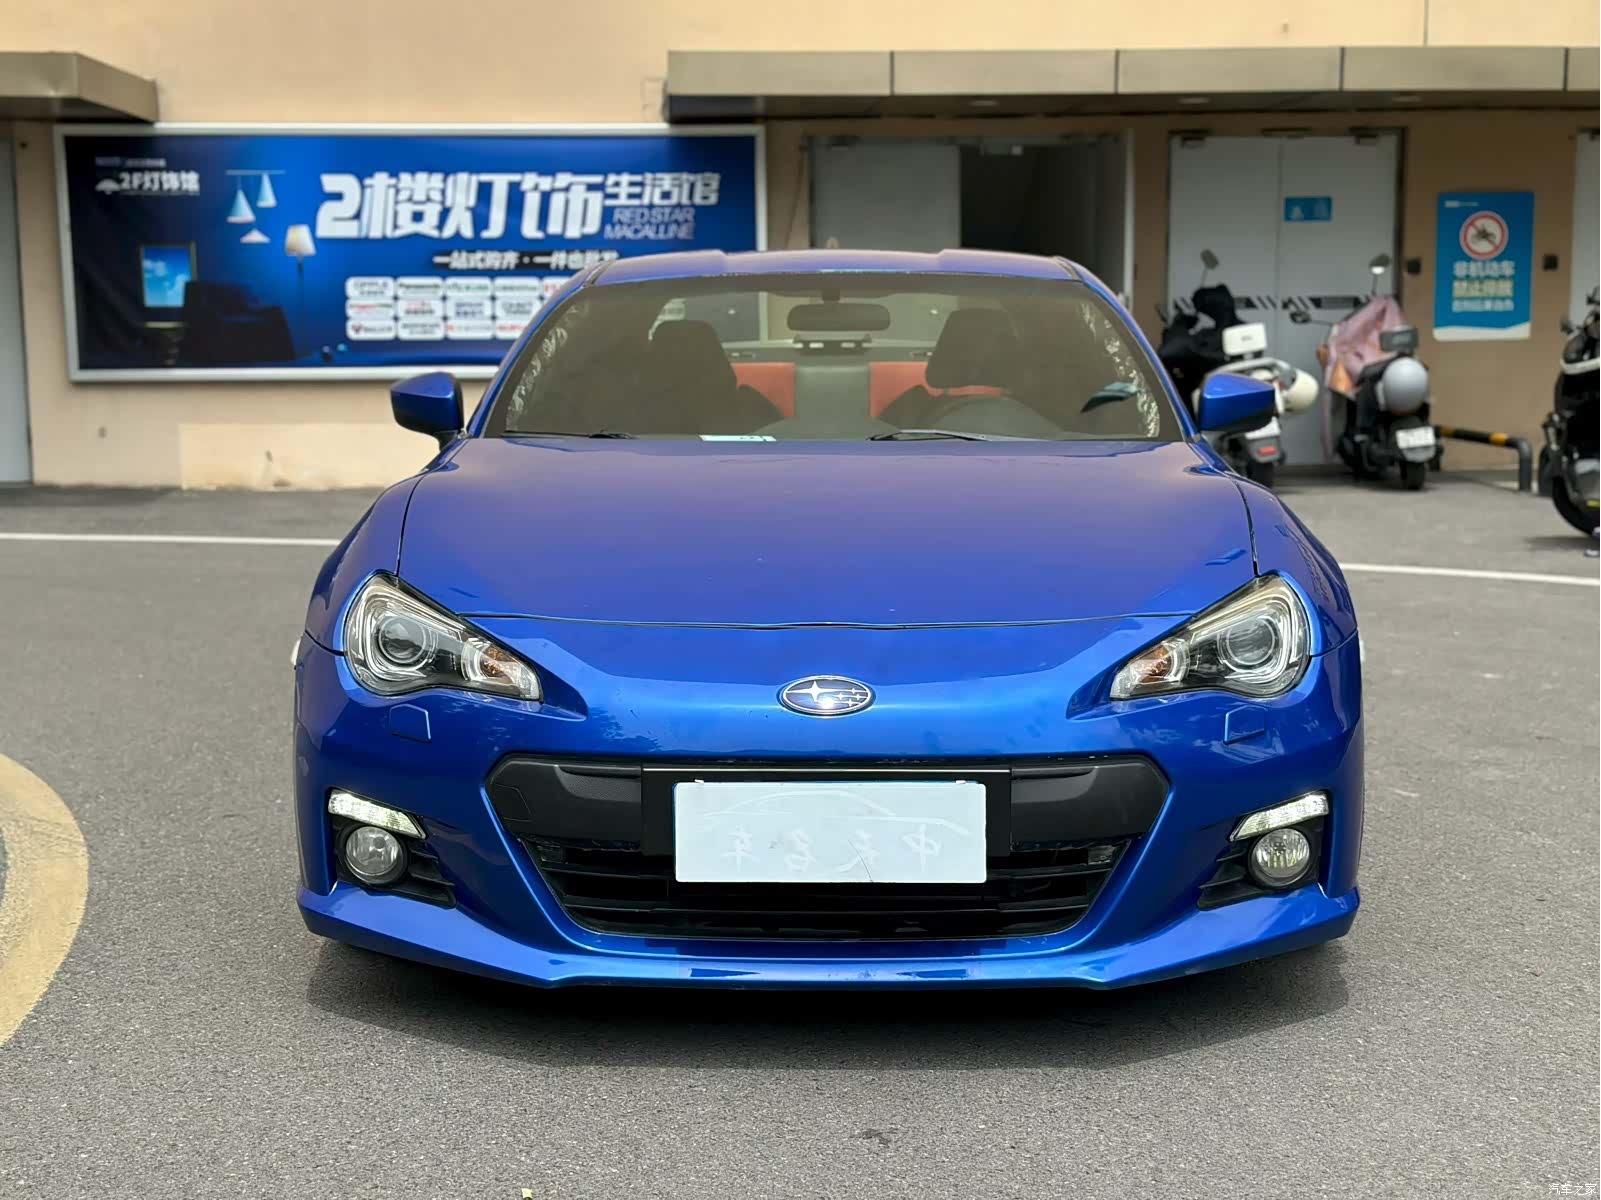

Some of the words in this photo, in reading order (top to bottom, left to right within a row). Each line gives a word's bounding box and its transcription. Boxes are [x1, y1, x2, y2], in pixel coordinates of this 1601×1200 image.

[315, 172, 606, 239] 2楼灯饰
[603, 172, 721, 207] 生活馆
[613, 207, 649, 224] RED
[650, 207, 695, 223] STAR
